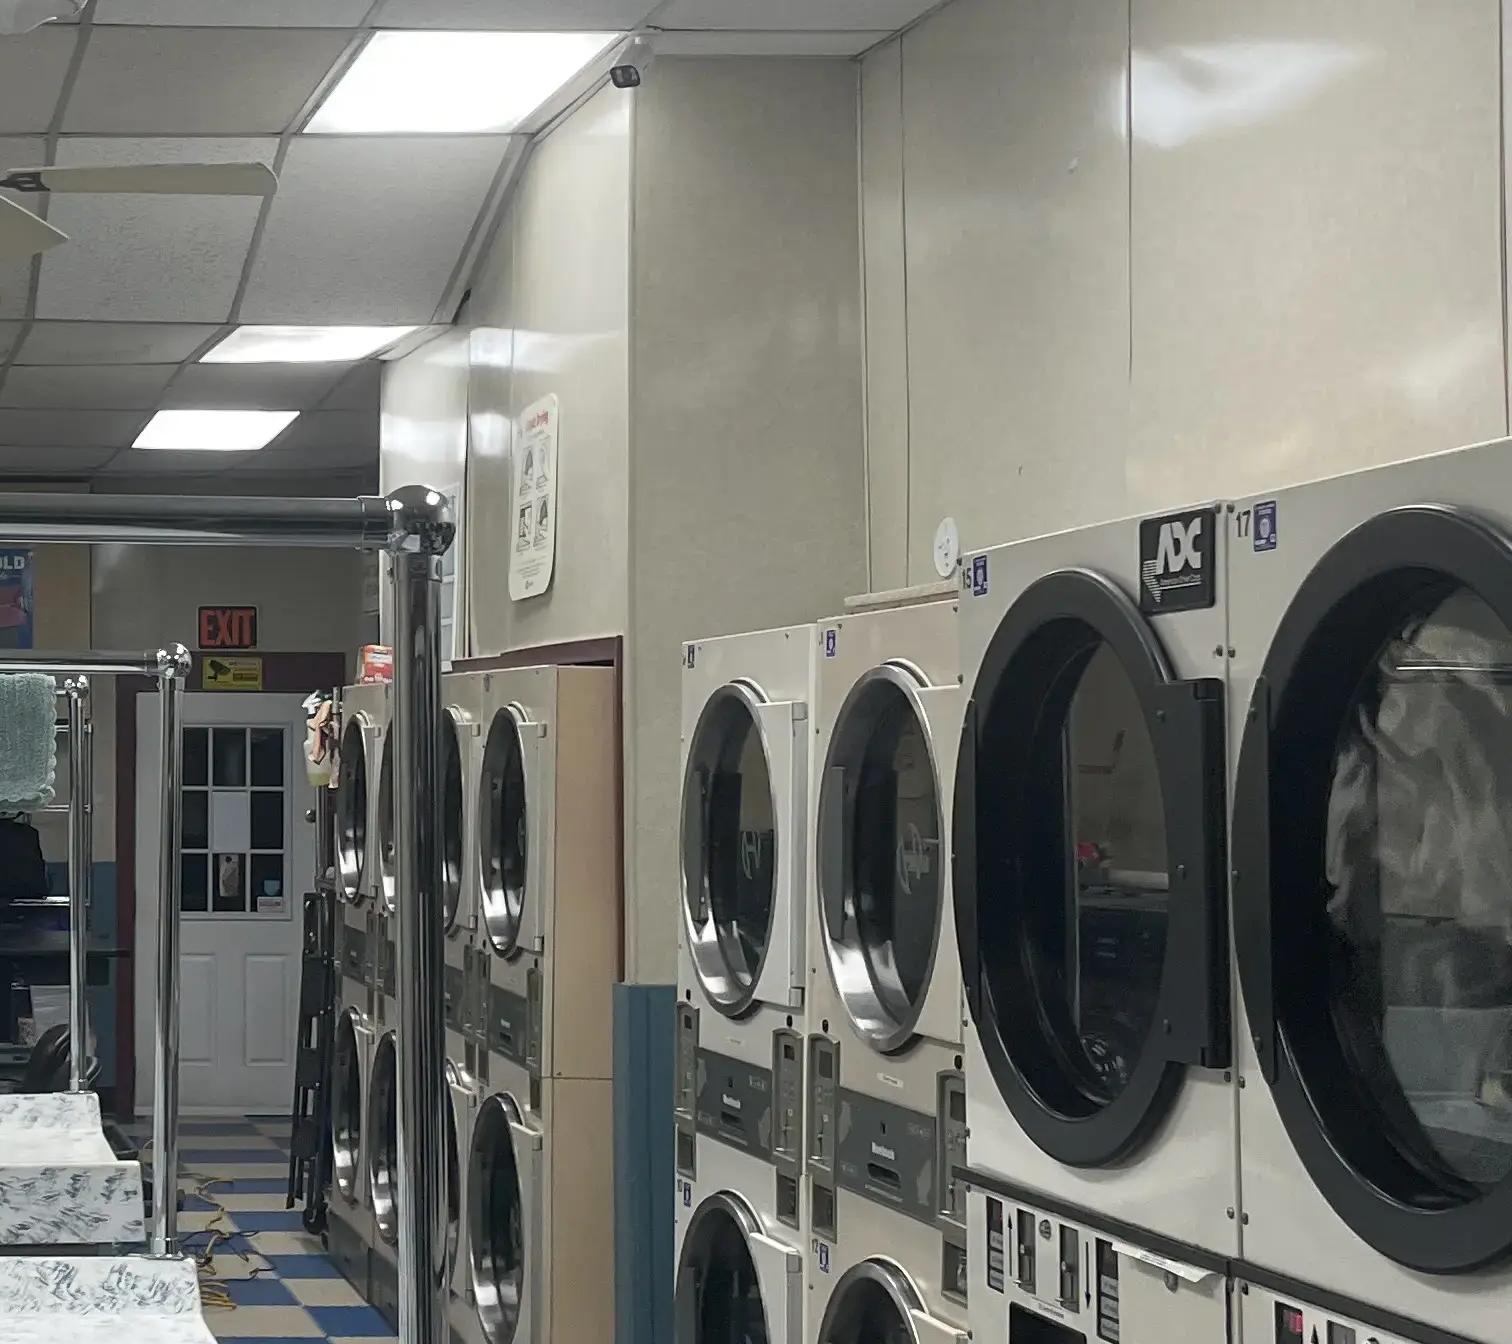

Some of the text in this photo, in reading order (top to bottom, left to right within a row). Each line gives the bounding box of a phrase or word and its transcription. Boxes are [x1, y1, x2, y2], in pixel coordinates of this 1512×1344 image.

[1236, 509, 1251, 538] 17
[1156, 516, 1202, 575] ADC
[962, 567, 972, 590] 15
[200, 609, 252, 646] EXIT
